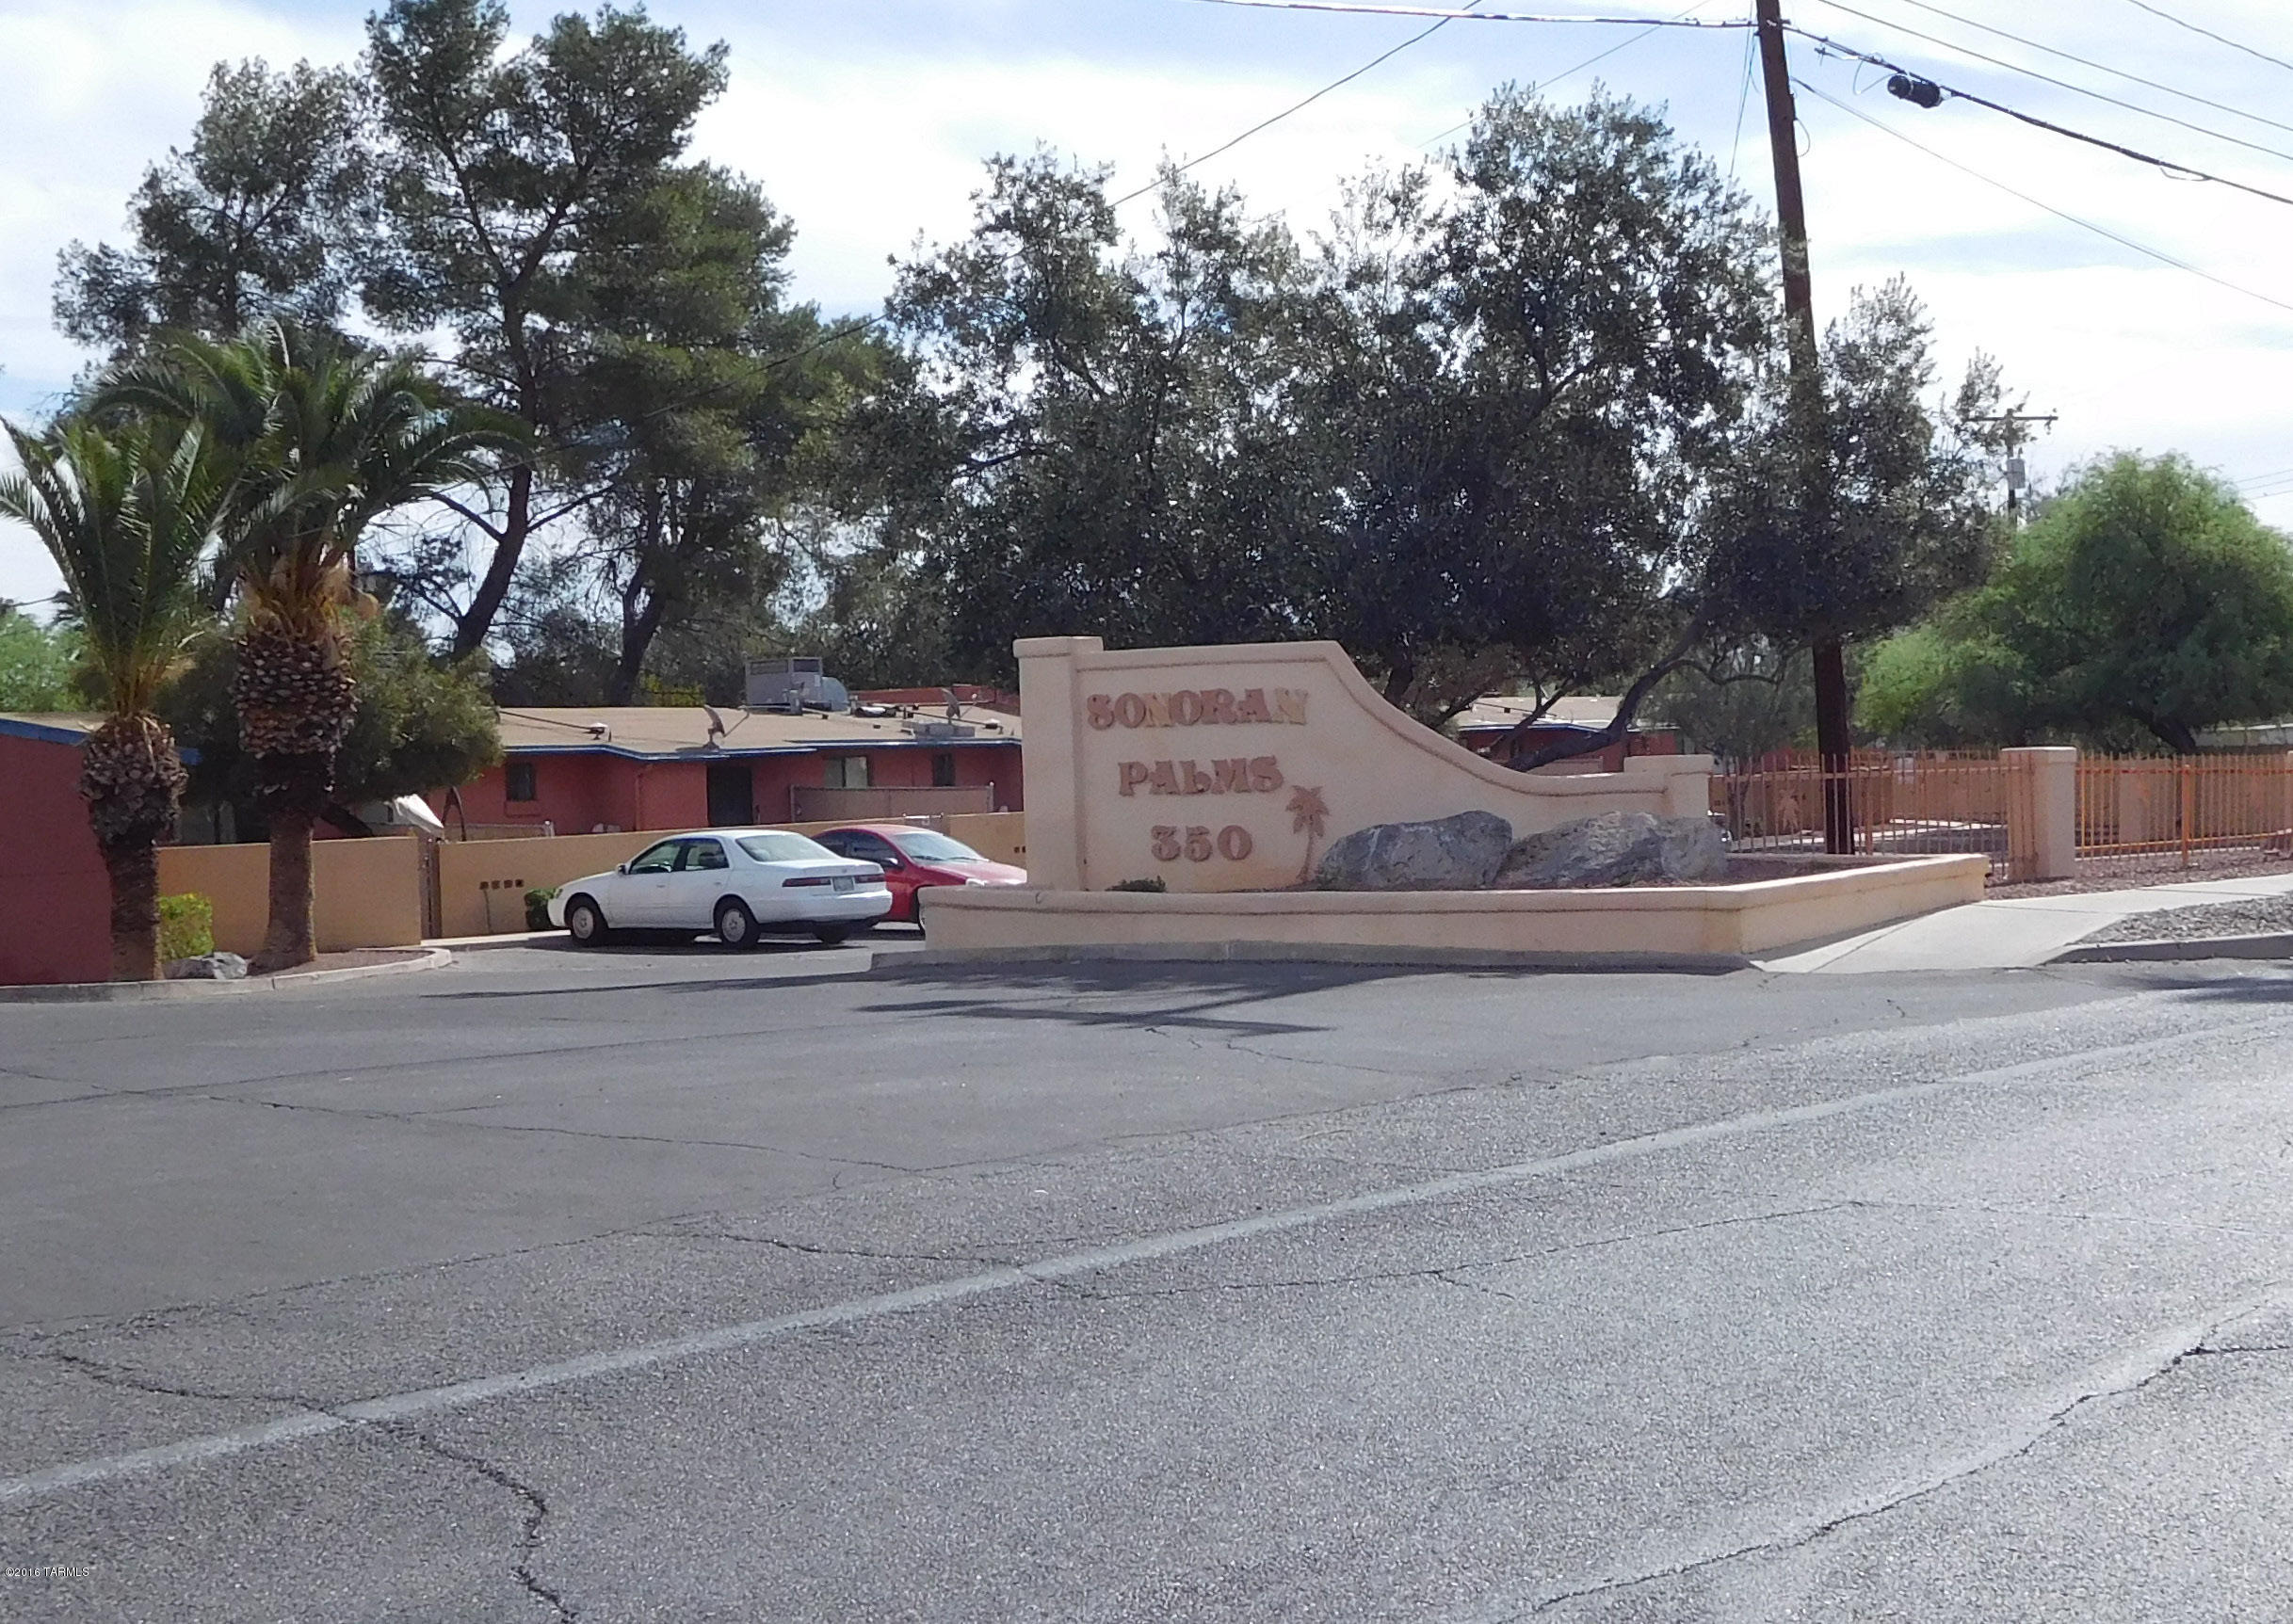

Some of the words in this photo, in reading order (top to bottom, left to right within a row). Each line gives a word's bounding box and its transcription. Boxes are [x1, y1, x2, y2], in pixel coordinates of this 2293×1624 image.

[1087, 689, 1308, 729] SONORAN
[1118, 756, 1284, 796] PALMS
[1152, 826, 1253, 861] 350
